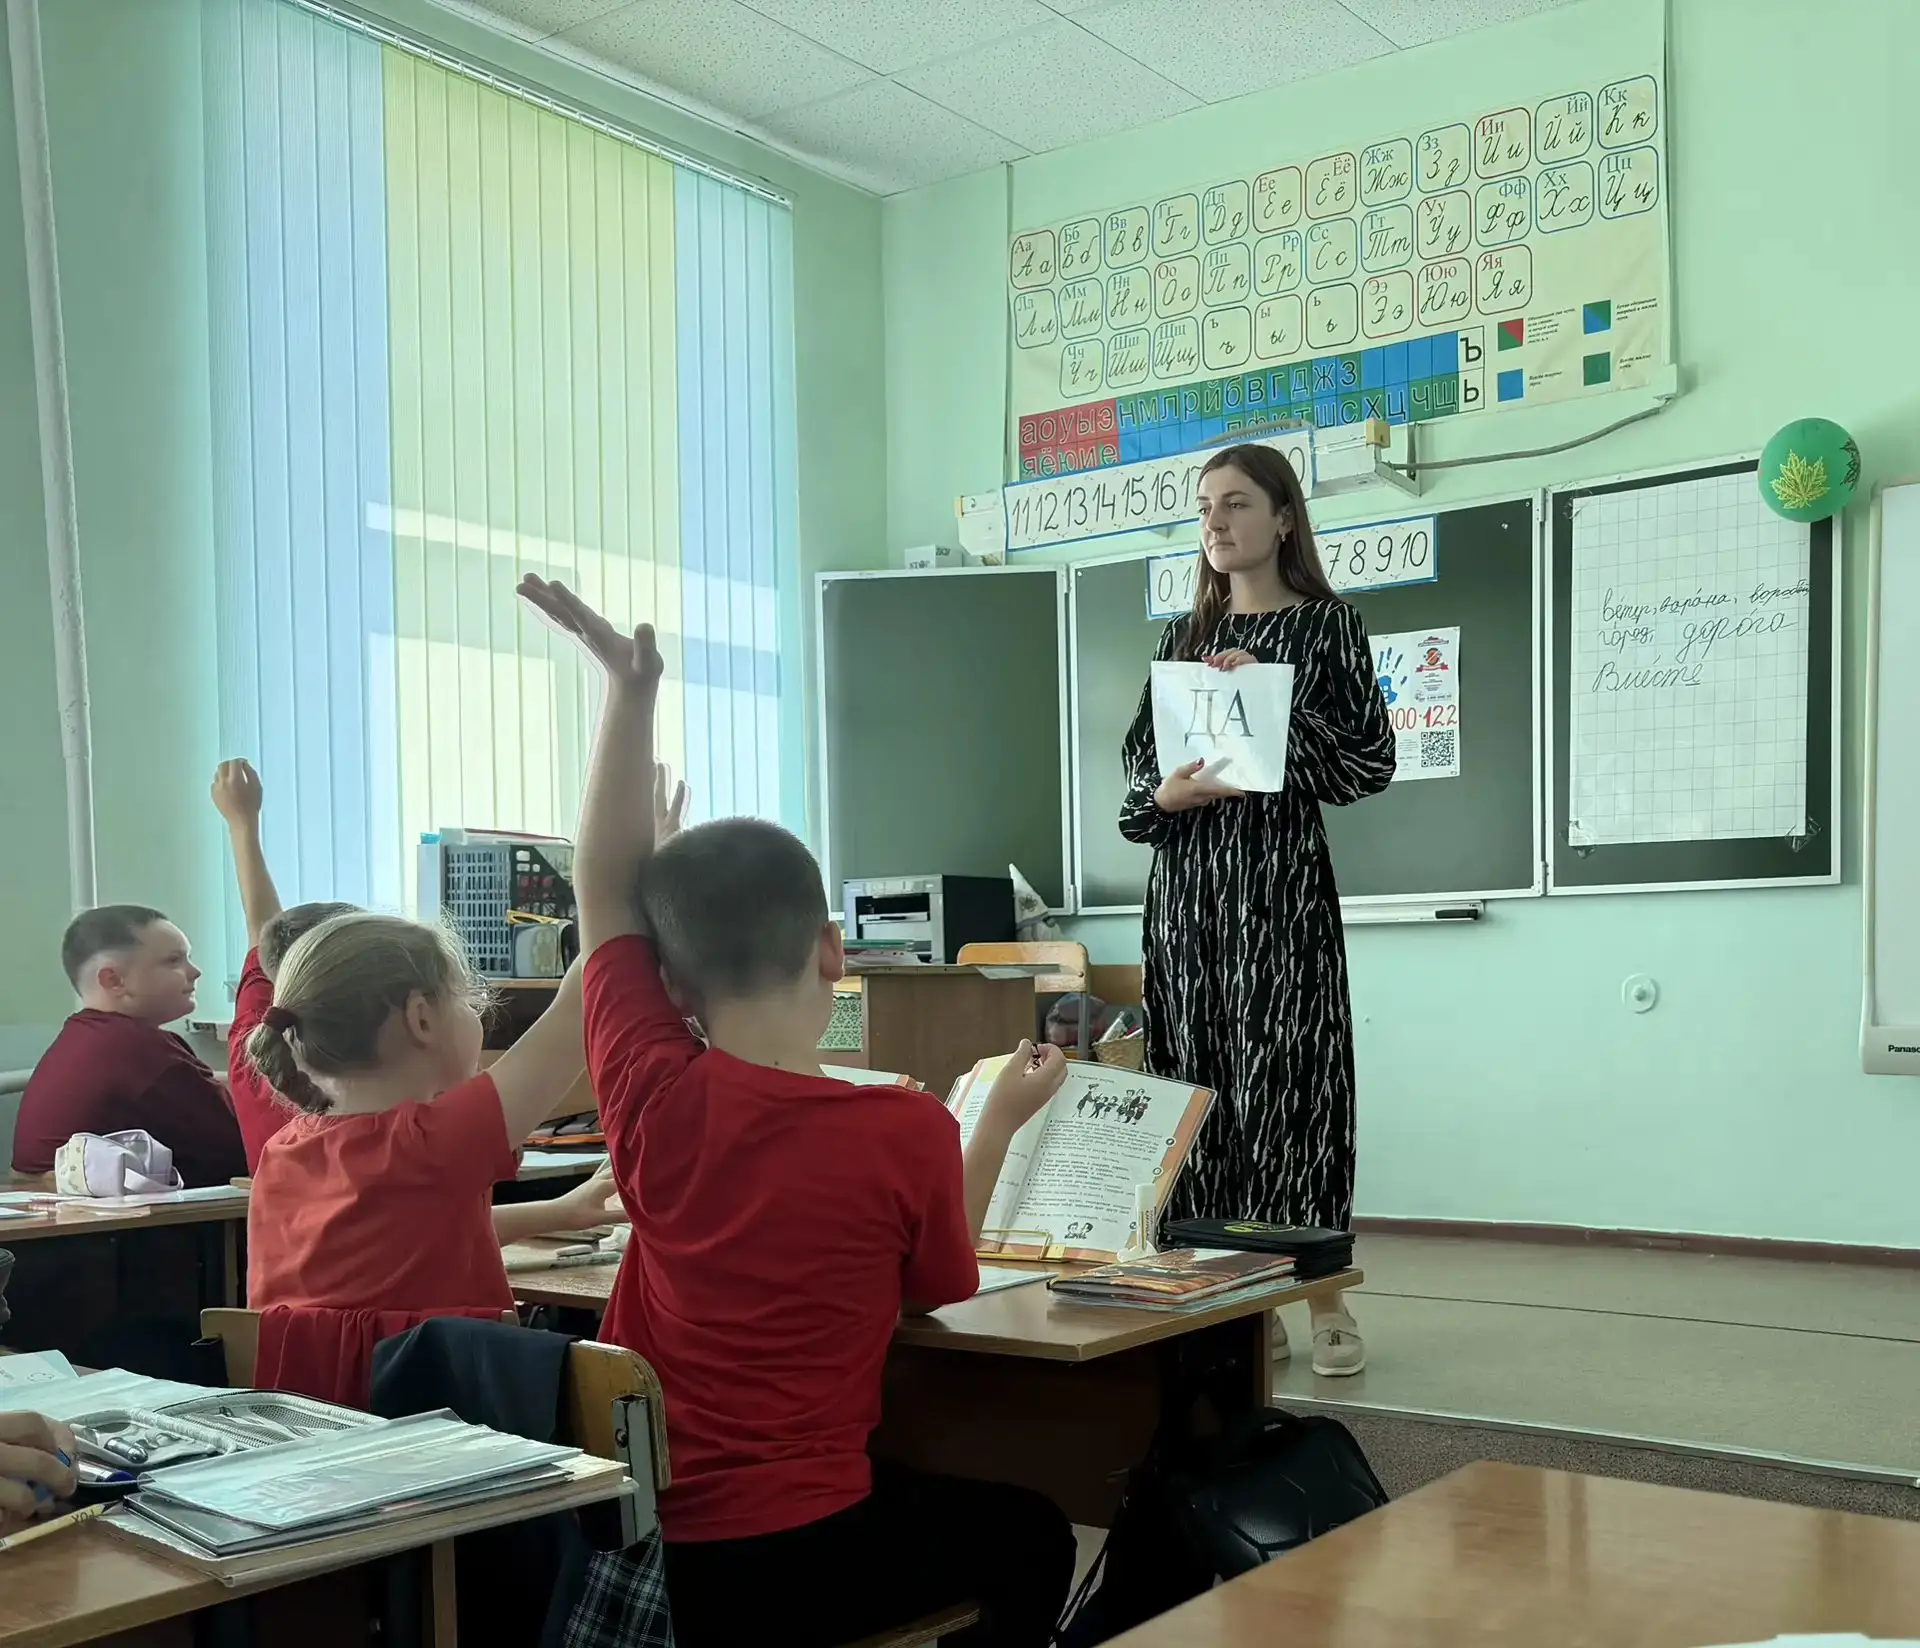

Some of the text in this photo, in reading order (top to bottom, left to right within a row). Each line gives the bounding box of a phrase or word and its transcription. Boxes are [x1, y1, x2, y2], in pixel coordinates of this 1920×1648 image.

[1012, 499, 1030, 536] 11
[1036, 491, 1058, 533] 12
[1063, 487, 1088, 527] 13
[1092, 483, 1116, 522] 14
[1121, 475, 1147, 518] 15
[1151, 470, 1177, 512] 16
[1325, 543, 1342, 580] 7
[1349, 539, 1366, 575] 8
[1375, 536, 1393, 572] 9
[1400, 531, 1428, 569] 10
[1676, 608, 1800, 664] дорога
[1184, 688, 1254, 748] ДА
